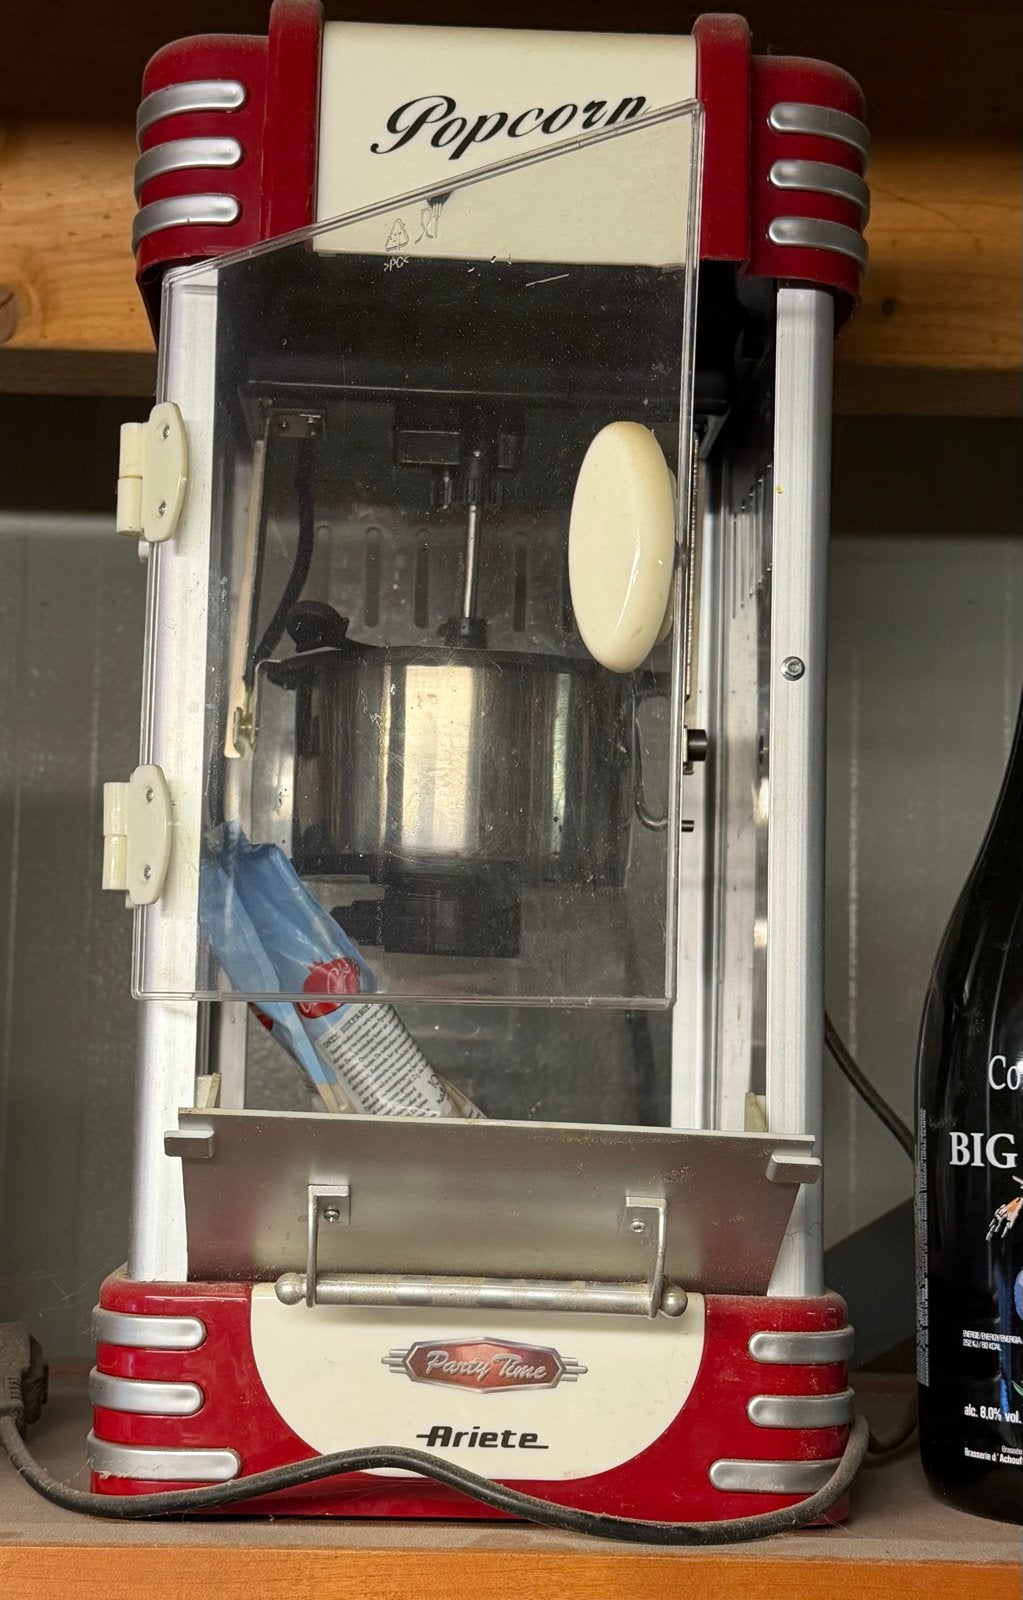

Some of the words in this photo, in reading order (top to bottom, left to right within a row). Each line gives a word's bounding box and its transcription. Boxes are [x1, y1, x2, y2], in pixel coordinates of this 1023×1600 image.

[370, 94, 648, 160] Popcorn
[340, 1003, 374, 1033] SUIKERBIE
[988, 1054, 1023, 1092] Co
[949, 1132, 1018, 1169] BIG
[424, 1350, 490, 1382] Party
[493, 1353, 547, 1380] Time
[963, 1403, 978, 1417] alc.
[1004, 1410, 1022, 1424] vol.
[416, 1425, 549, 1449] Ariete
[964, 1447, 991, 1461] Brasserie
